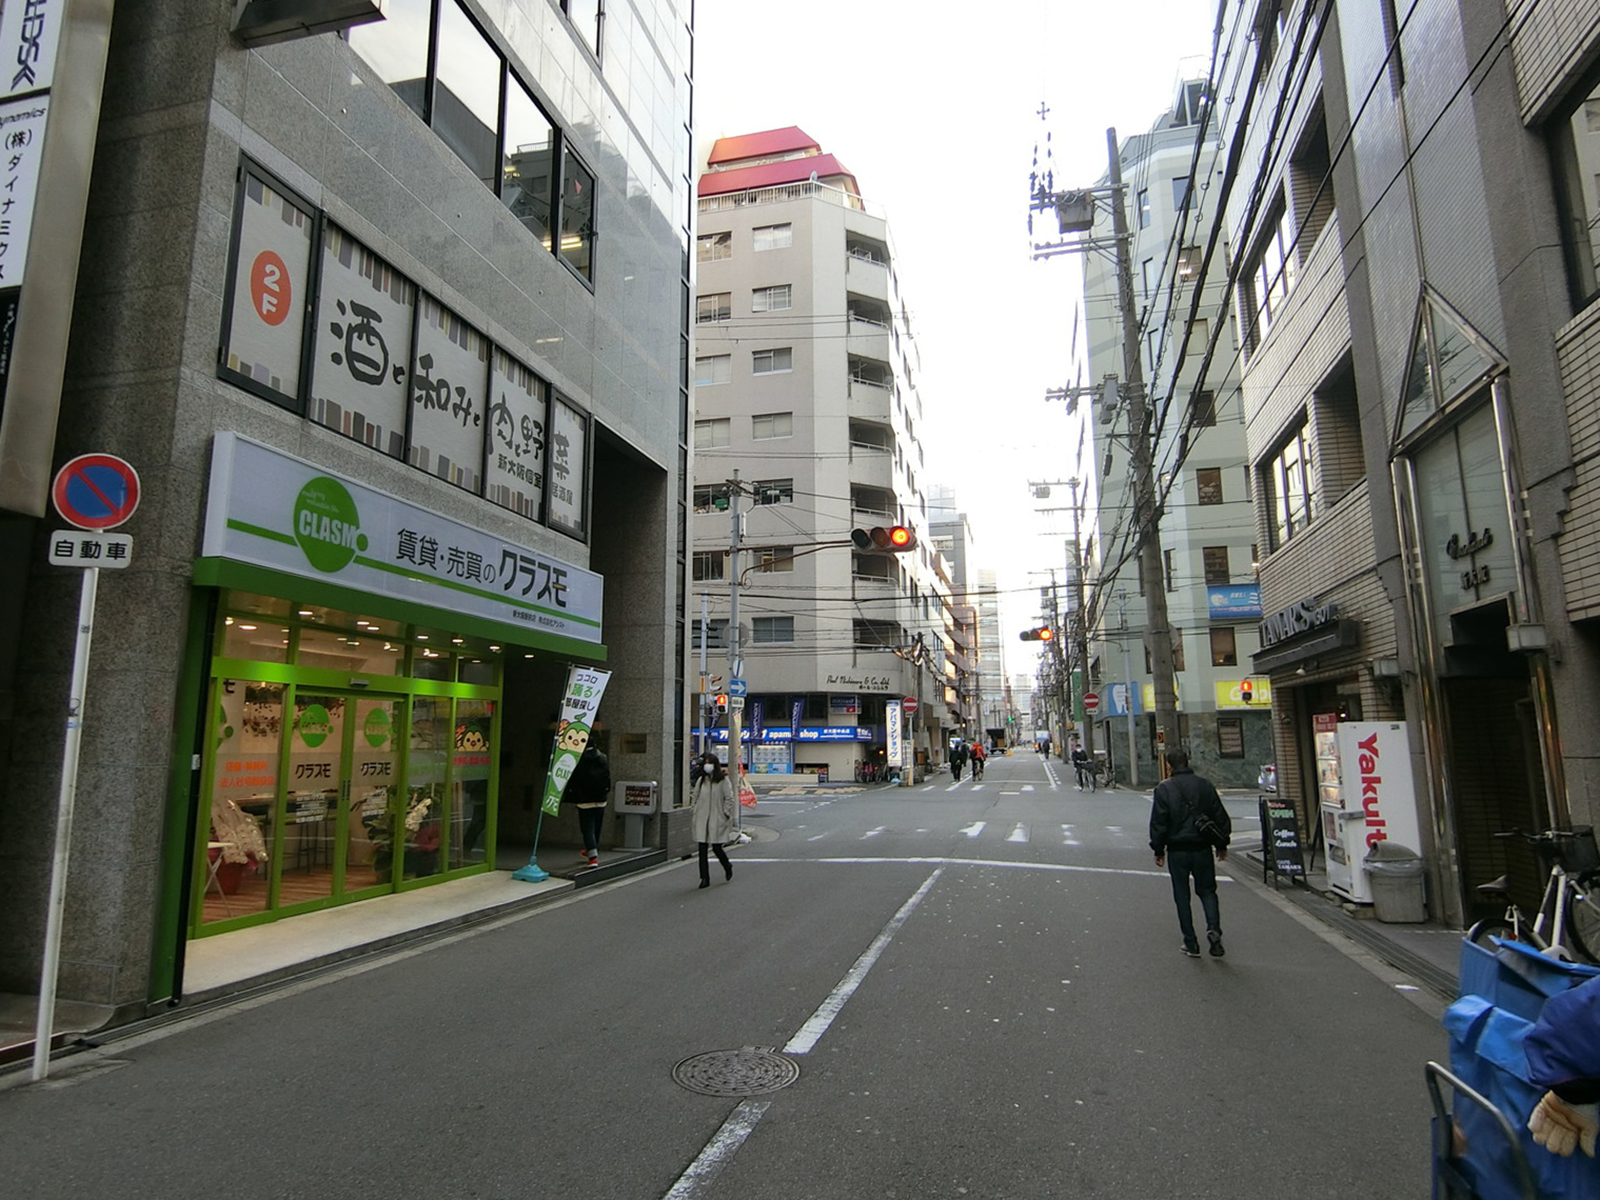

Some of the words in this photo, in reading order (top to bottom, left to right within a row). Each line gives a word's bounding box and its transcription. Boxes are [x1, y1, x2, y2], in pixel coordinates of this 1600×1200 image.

[262, 264, 280, 315] 2F
[54, 539, 128, 560] 自動車
[576, 673, 598, 685] ココロ
[295, 763, 331, 779] クラスモ
[361, 762, 391, 777] クラスモ
[1357, 732, 1387, 850] Yakult
[1273, 829, 1295, 838] Coffee
